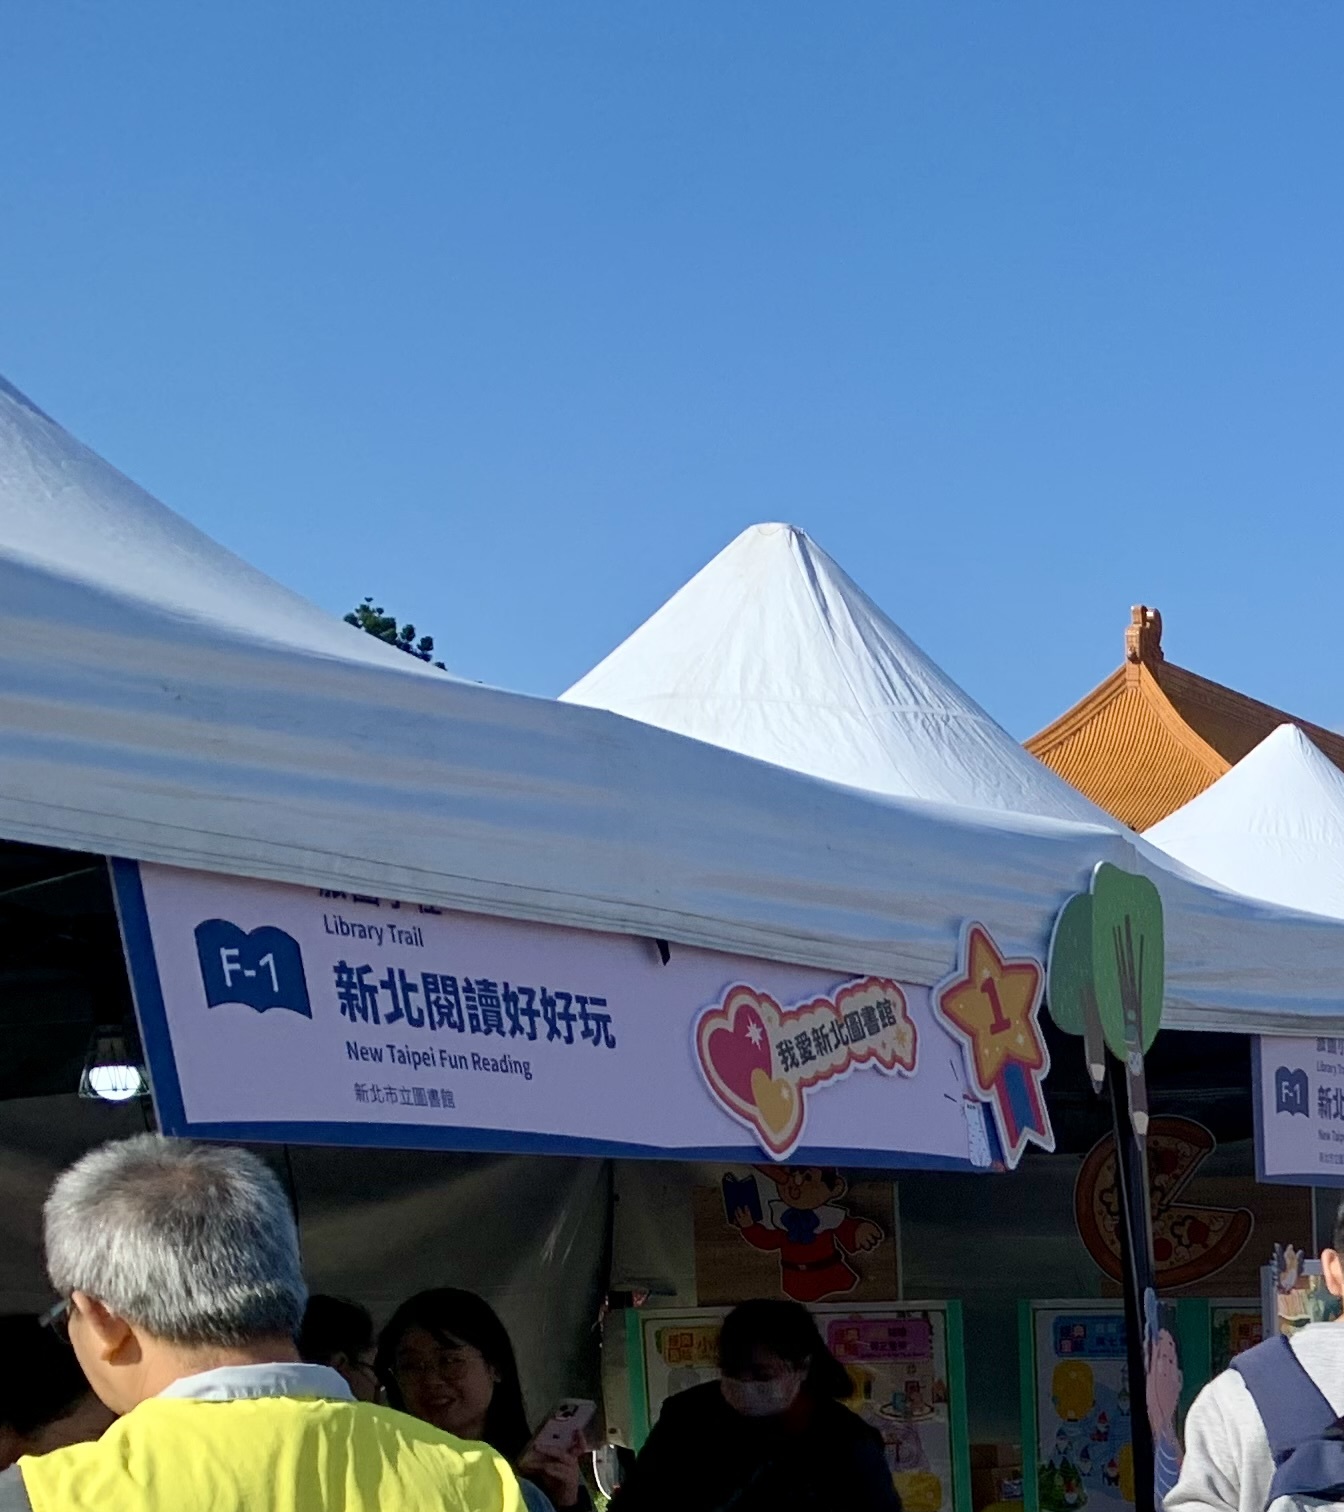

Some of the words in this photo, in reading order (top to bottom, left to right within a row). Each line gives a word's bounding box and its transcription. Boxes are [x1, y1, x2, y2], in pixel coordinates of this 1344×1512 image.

[323, 914, 384, 946] Library
[387, 924, 424, 947] Trail
[220, 948, 279, 992] F-1
[333, 960, 616, 1049] 新北閱讀好好玩
[980, 977, 1011, 1036] 1
[776, 998, 897, 1073] 我愛新北圖書館
[346, 1041, 383, 1062] New
[386, 1044, 436, 1070] Taipei
[440, 1049, 468, 1071] Fun
[473, 1052, 532, 1080] Reading
[354, 1082, 456, 1109] 新北市立圖書館
[1281, 1081, 1301, 1104] F-1
